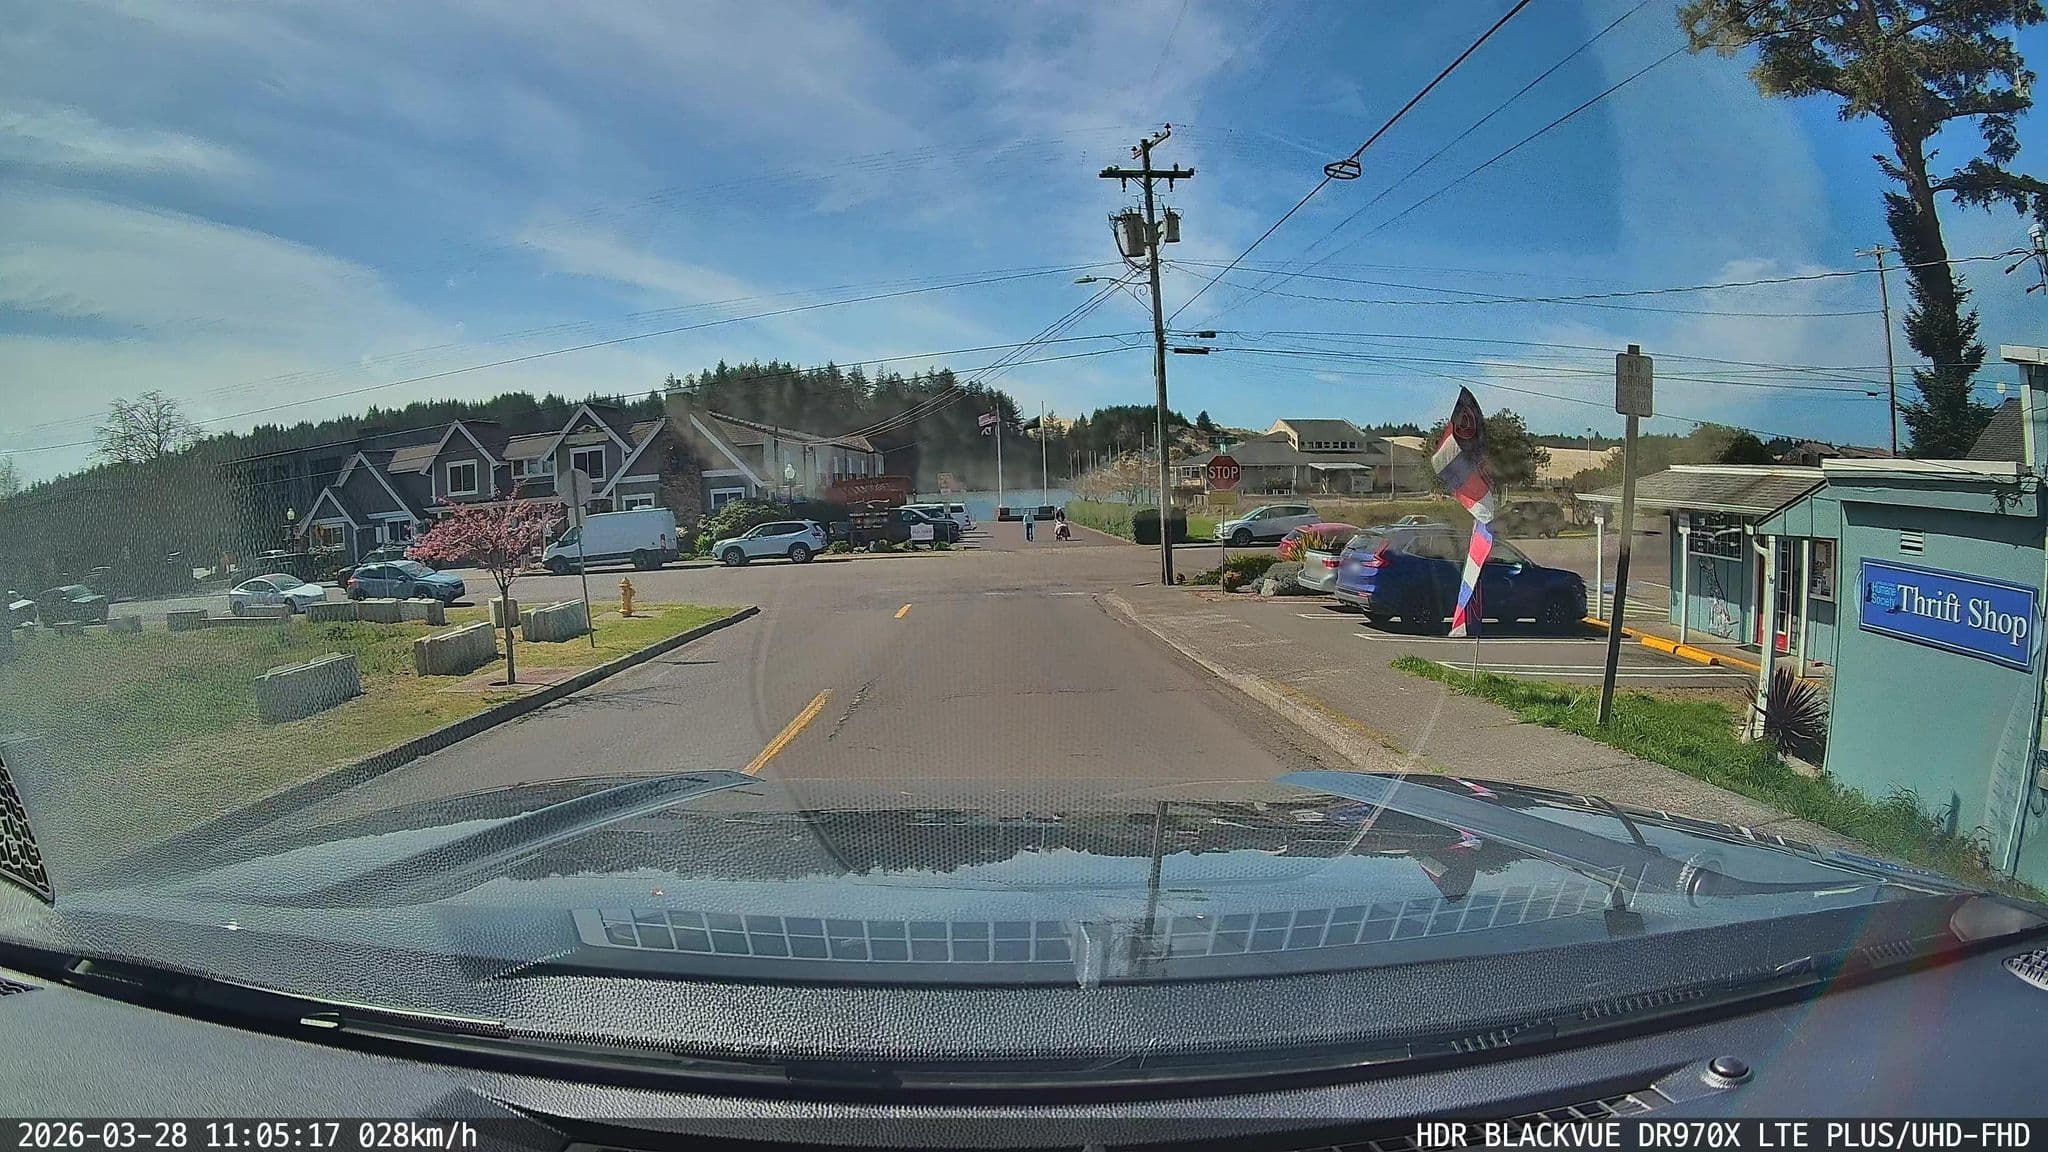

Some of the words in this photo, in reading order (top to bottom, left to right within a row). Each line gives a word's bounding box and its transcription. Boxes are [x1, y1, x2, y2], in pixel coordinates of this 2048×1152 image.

[1208, 466, 1239, 479] STOP
[1872, 580, 1897, 597] Humane
[1871, 593, 1897, 609] Society
[1897, 583, 1962, 624] Thrift
[1967, 597, 2028, 647] Shop
